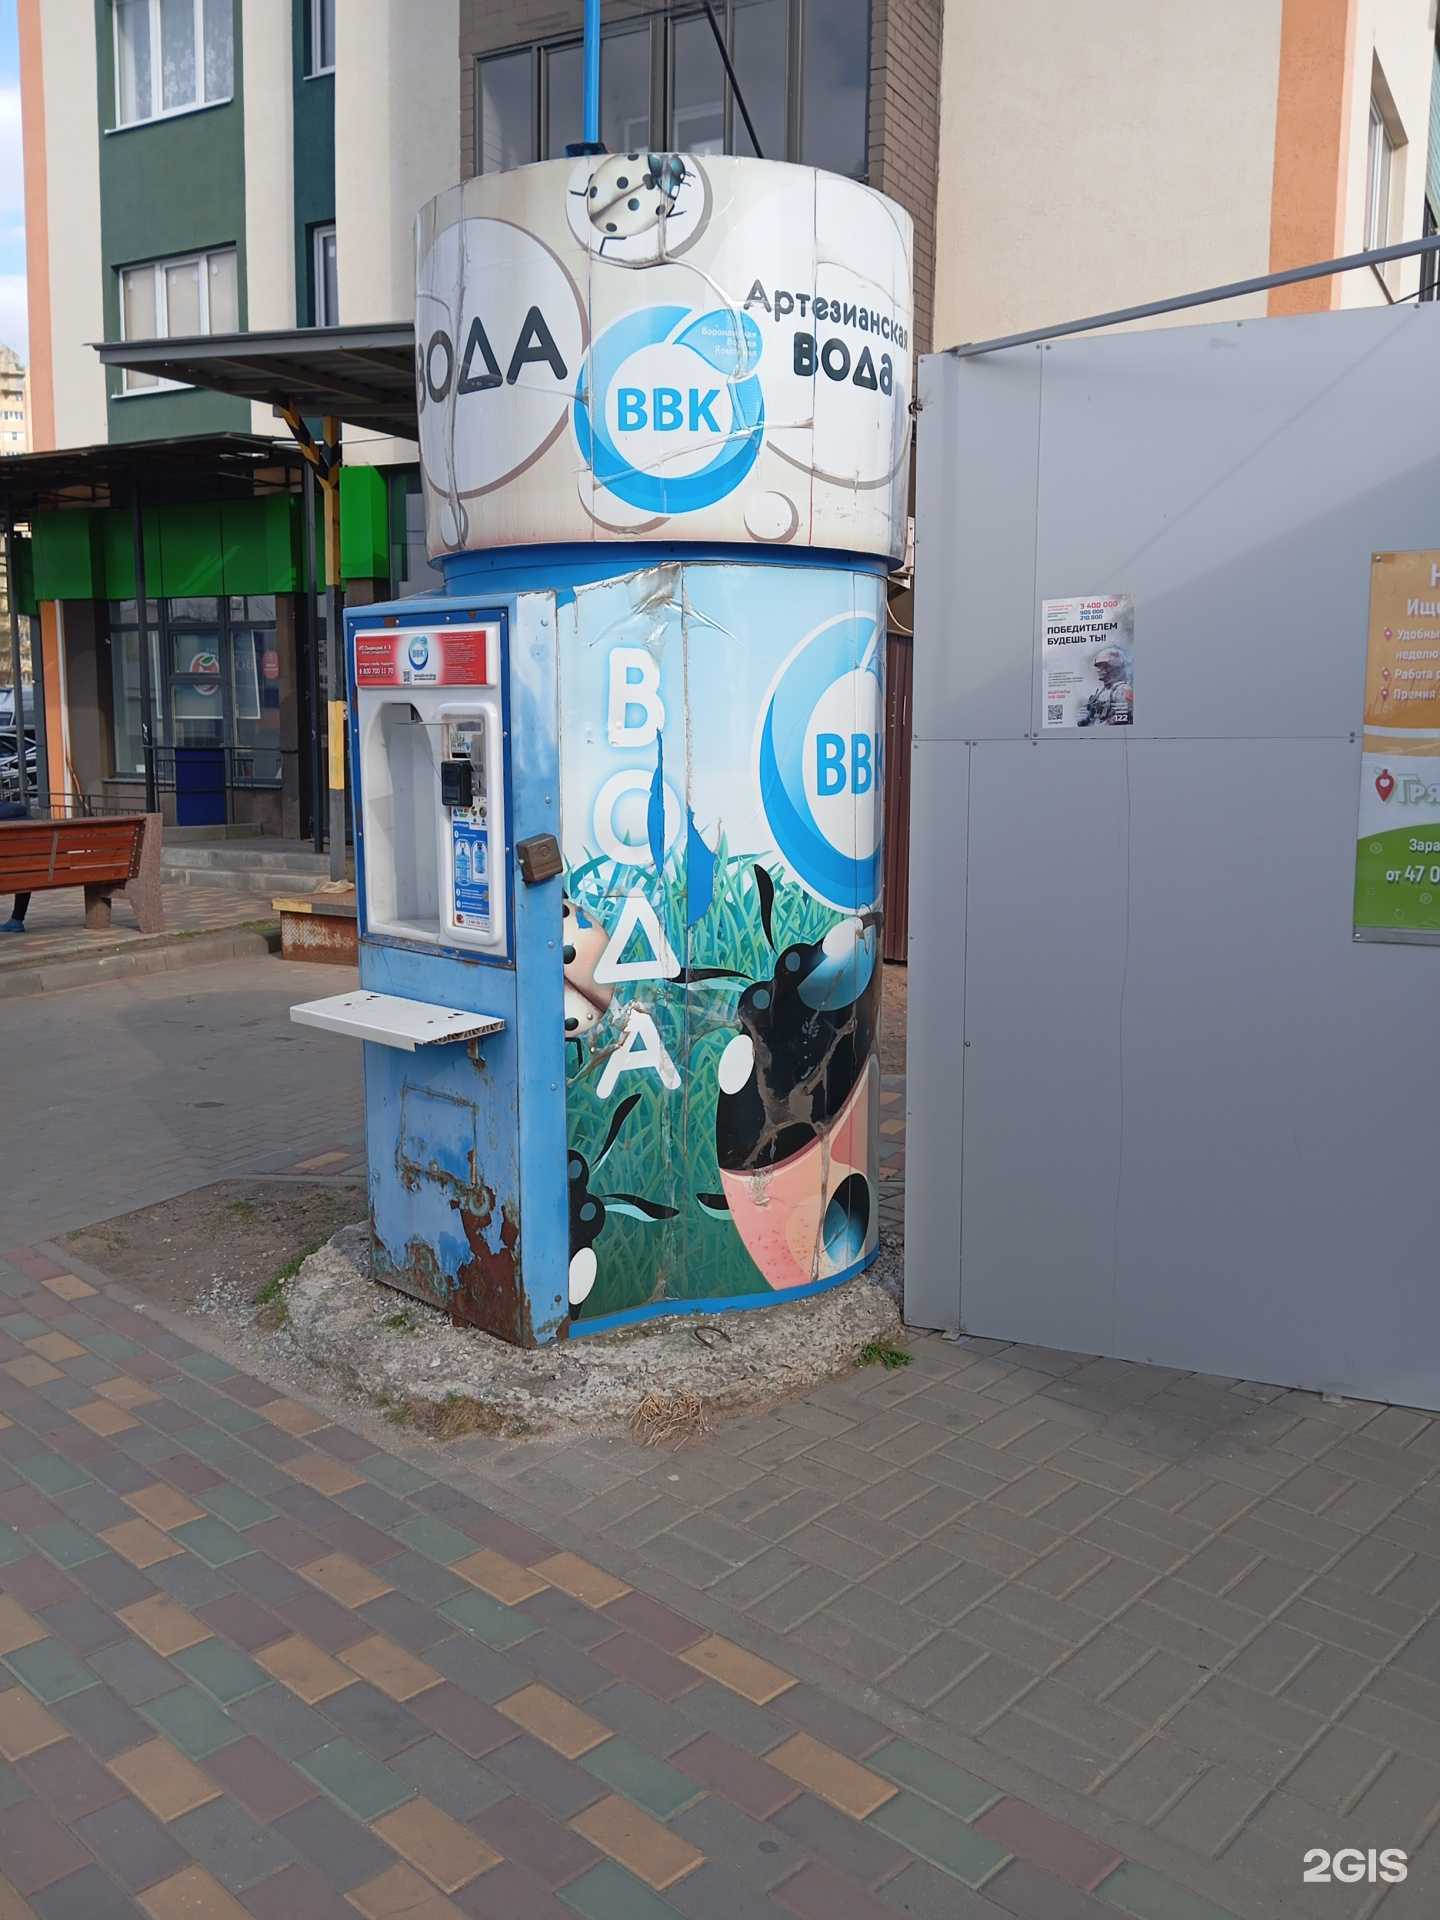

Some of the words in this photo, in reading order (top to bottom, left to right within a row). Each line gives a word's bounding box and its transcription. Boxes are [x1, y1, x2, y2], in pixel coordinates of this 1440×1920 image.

[743, 279, 908, 352] Артезианская
[617, 387, 721, 433] ВВК
[1047, 622, 1118, 635] ПОБЕДИТЕЛЕМ
[1047, 635, 1086, 645] БУДЕШЬ
[1395, 668, 1432, 680] Работа
[1393, 689, 1435, 701] Премия
[592, 647, 682, 1099] ВОДА
[1386, 870, 1401, 881] от
[1405, 865, 1425, 882] 47
